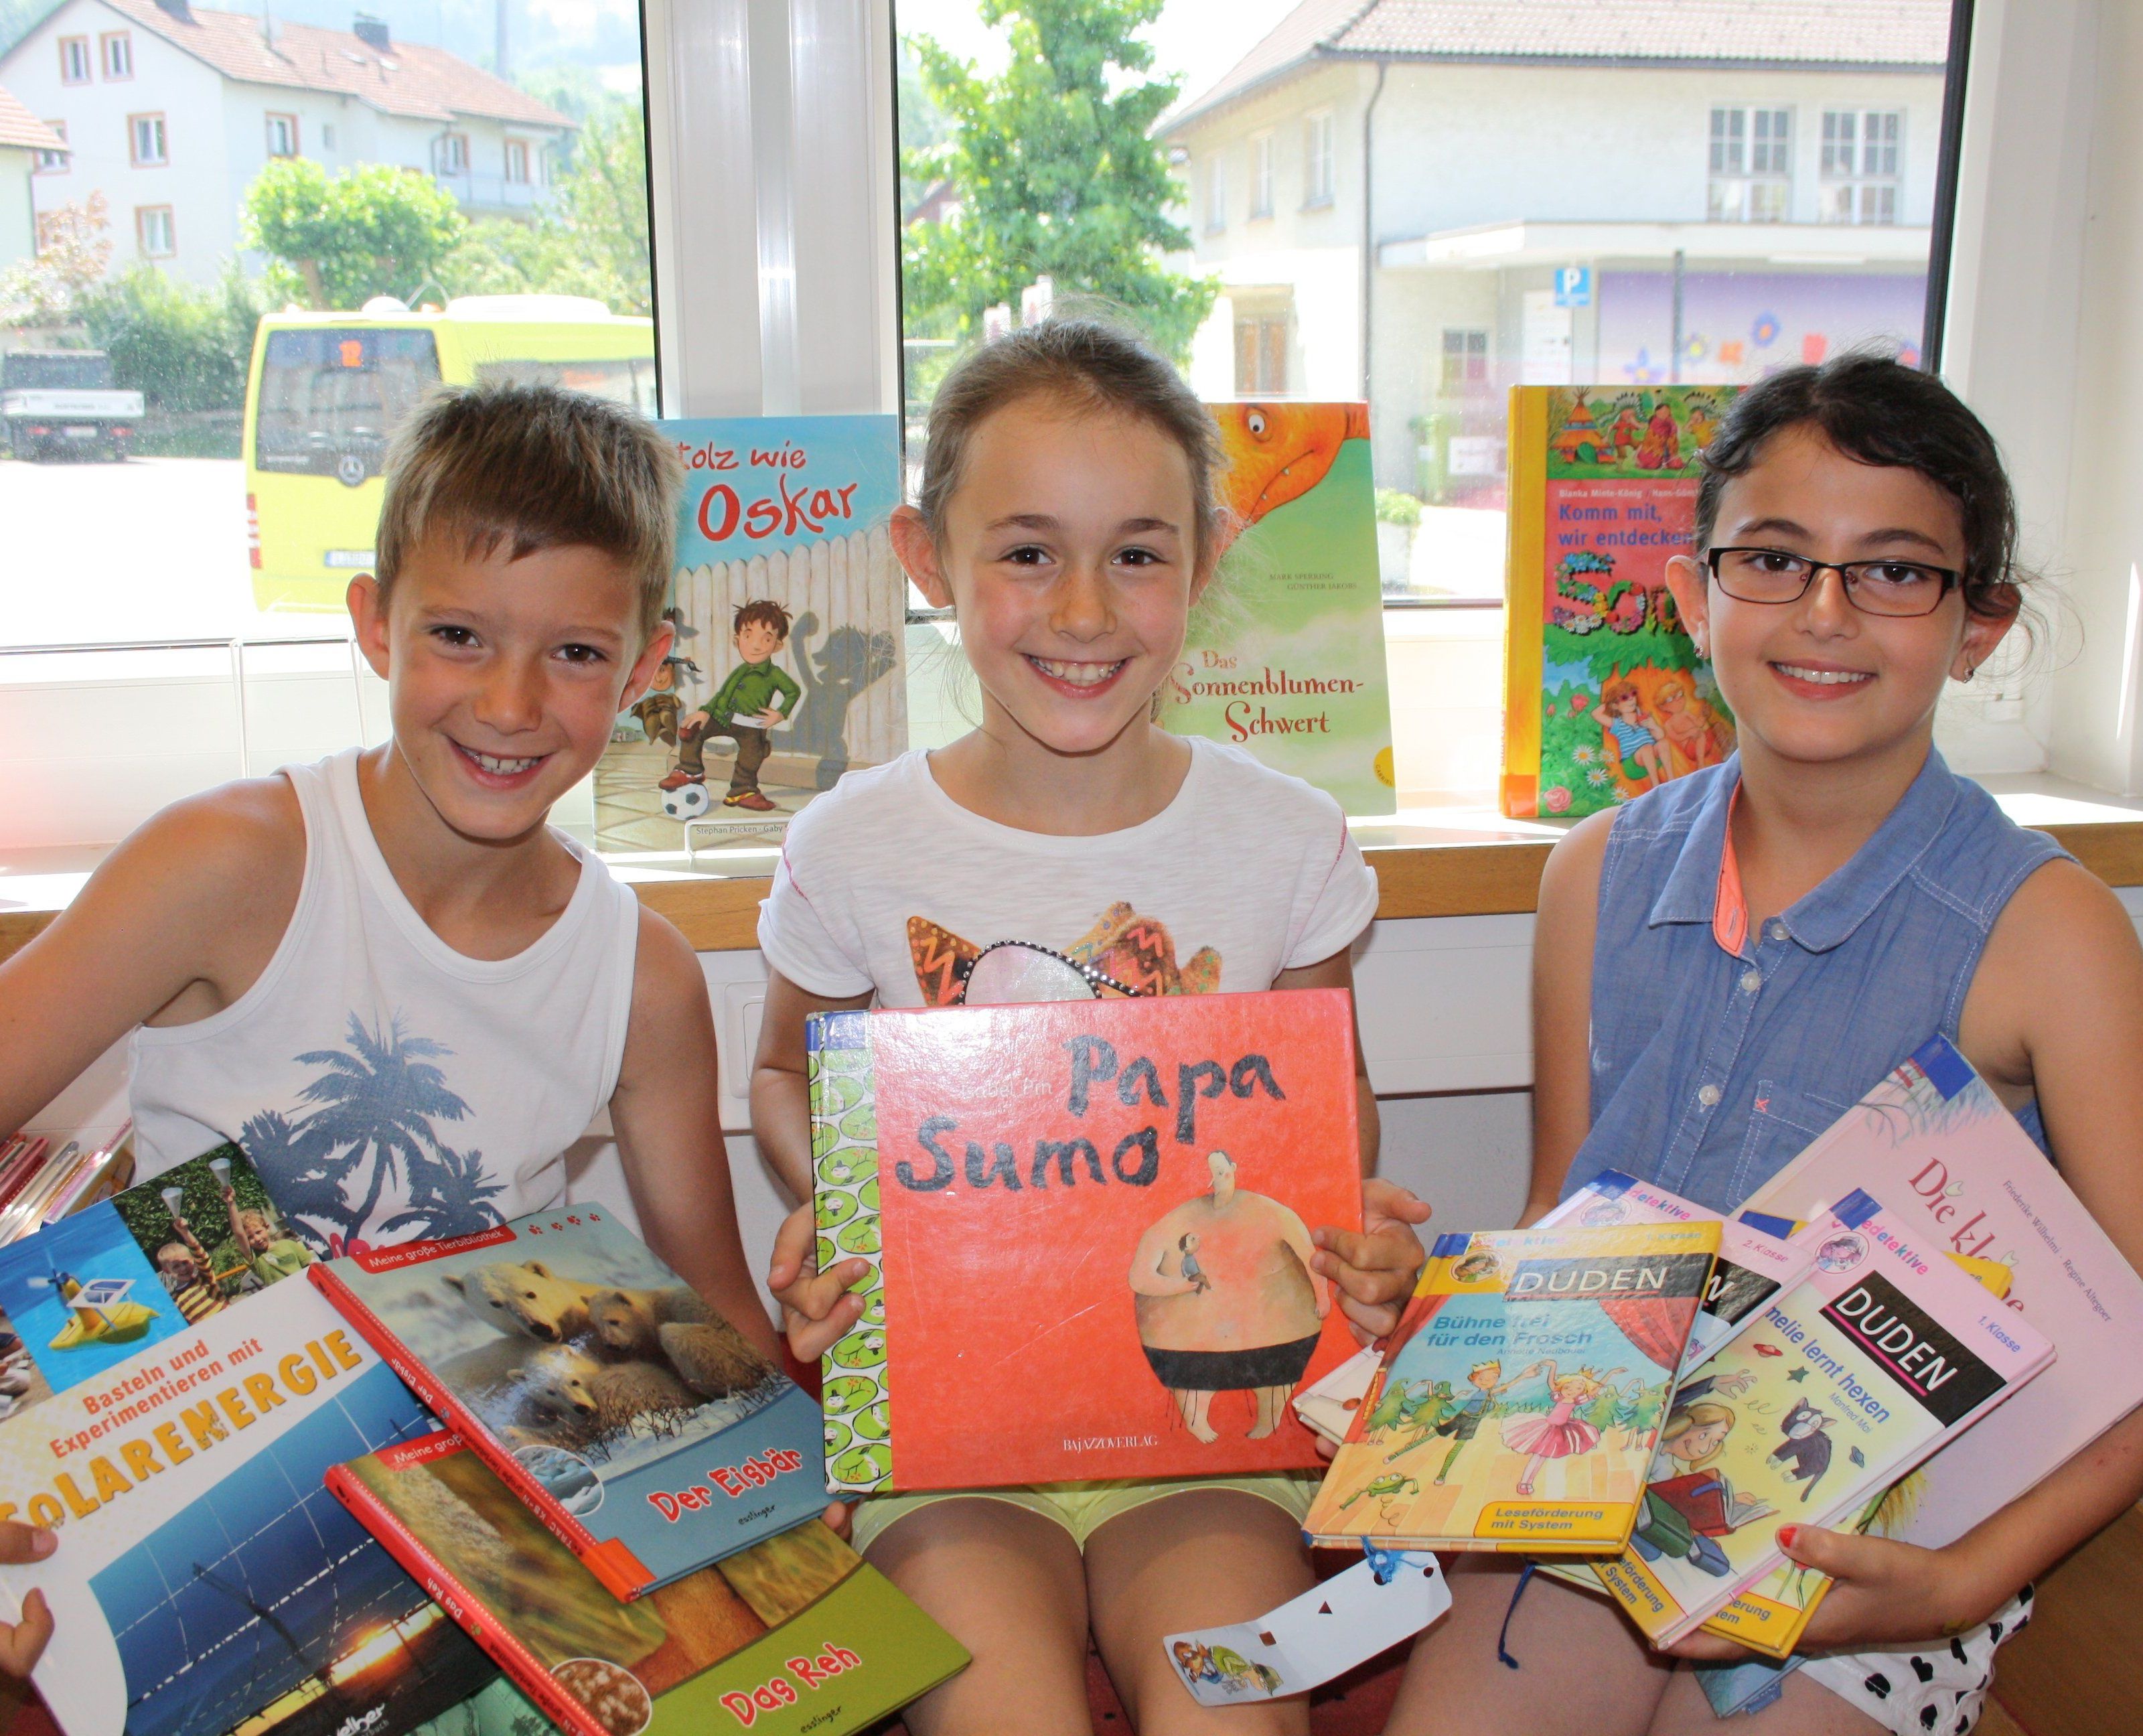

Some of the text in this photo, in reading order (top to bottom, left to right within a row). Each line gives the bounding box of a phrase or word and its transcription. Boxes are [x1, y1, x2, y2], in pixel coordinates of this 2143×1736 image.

[1564, 267, 1582, 295] P
[678, 440, 806, 469] tolz wie
[698, 474, 857, 541] Oskar
[1559, 504, 1662, 522] Komm mit,
[1558, 529, 1588, 545] wir
[1201, 650, 1237, 669] Das
[1170, 662, 1364, 705] Sonnenblumen-
[1225, 701, 1331, 743] Schwert
[696, 824, 783, 835] Stephan Pricken Gaby
[1063, 1035, 1286, 1145] Papa
[895, 1116, 1159, 1192] Sumo
[1626, 1188, 1691, 1220] detektive
[1908, 1157, 1958, 1224] Die
[368, 1229, 504, 1268] Meine große Tierbibliothek
[1755, 1243, 1789, 1262] Klasse
[1861, 1218, 1929, 1277] edetektive
[2002, 1180, 2112, 1323] Friederike Wilhelmi Regine Altegoer
[1514, 1267, 1670, 1293] DUDEN
[1427, 1331, 1593, 1346] für den Frosch
[1433, 1315, 1505, 1329] Bühne
[1835, 1286, 1959, 1393] DUDEN
[1985, 1321, 2021, 1353] Klasse
[82, 1340, 210, 1415] Basteln und
[1765, 1306, 1891, 1424] melie lernt hexen
[49, 1337, 265, 1459] Experimentieren mit
[418, 1383, 434, 1405] Der
[1828, 1392, 1873, 1434] Manfred Mai
[394, 1433, 462, 1463] Meine groß
[647, 1448, 802, 1524] Der Eisbär
[738, 1503, 776, 1526] esslinger
[1491, 1519, 1573, 1532] mit System
[1495, 1507, 1604, 1522] Leseförderung
[427, 1577, 463, 1619] Das Reh
[1605, 1566, 1638, 1605] System
[1615, 1554, 1664, 1613] eförderung
[719, 1642, 862, 1728] Das Reh
[327, 1702, 386, 1736] elber
[800, 1705, 842, 1733] esslinger
